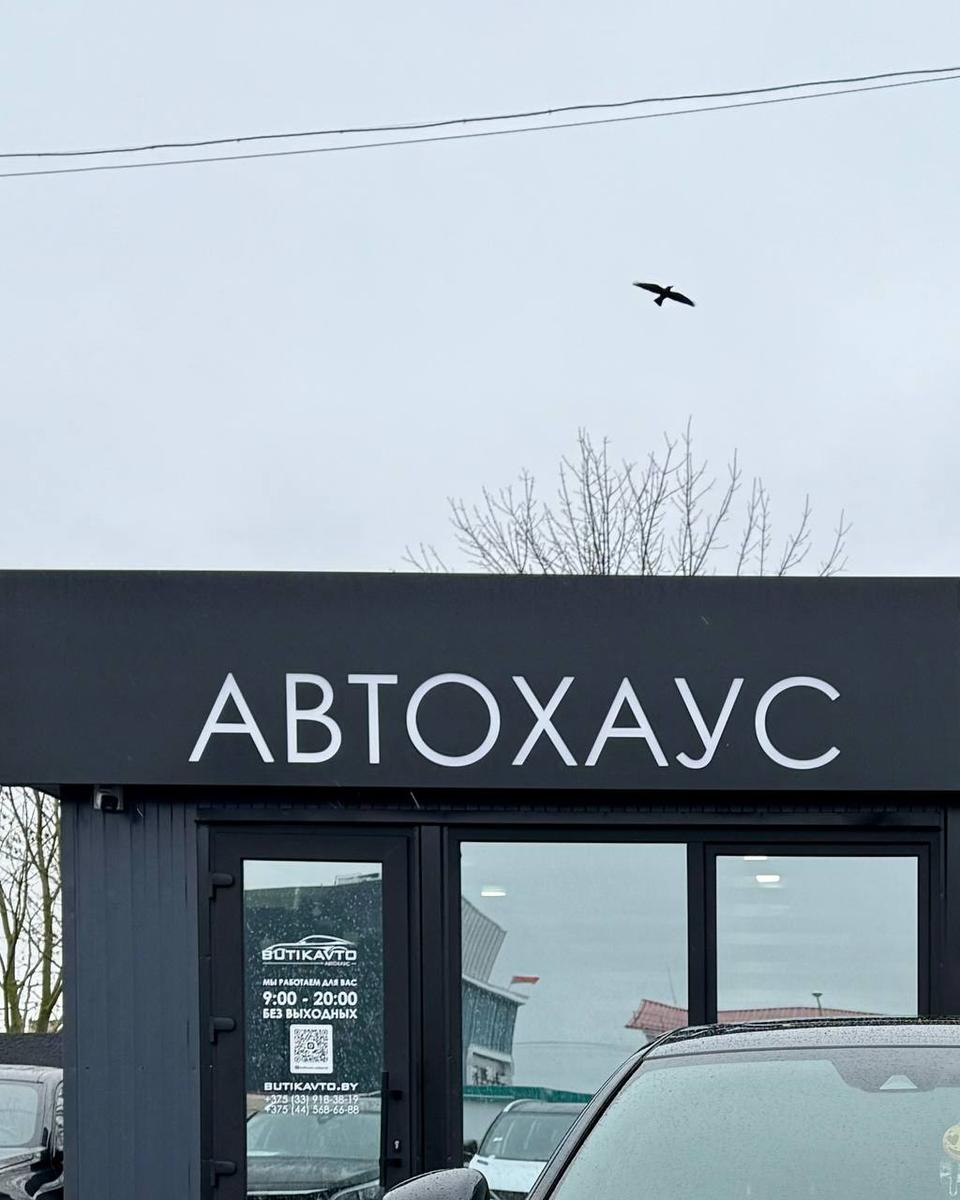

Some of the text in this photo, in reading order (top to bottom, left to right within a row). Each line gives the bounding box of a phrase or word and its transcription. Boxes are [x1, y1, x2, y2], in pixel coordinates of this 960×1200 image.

[188, 671, 841, 770] АВТОХАУС
[262, 949, 357, 960] BUTIKAVTO
[263, 978, 357, 987] МЫ РАБОТАЕМ ДЛЯ ВАС
[263, 991, 297, 1005] 9:00
[313, 991, 358, 1005] 20:00
[263, 1009, 358, 1020] БЕЗ ВЫХОДНЫХ
[264, 1082, 359, 1091] BUTIKAVTO.BY
[265, 1095, 359, 1105] +375 (33) 918-38-19
[264, 1105, 359, 1116] +375 (44) 568-66-88
